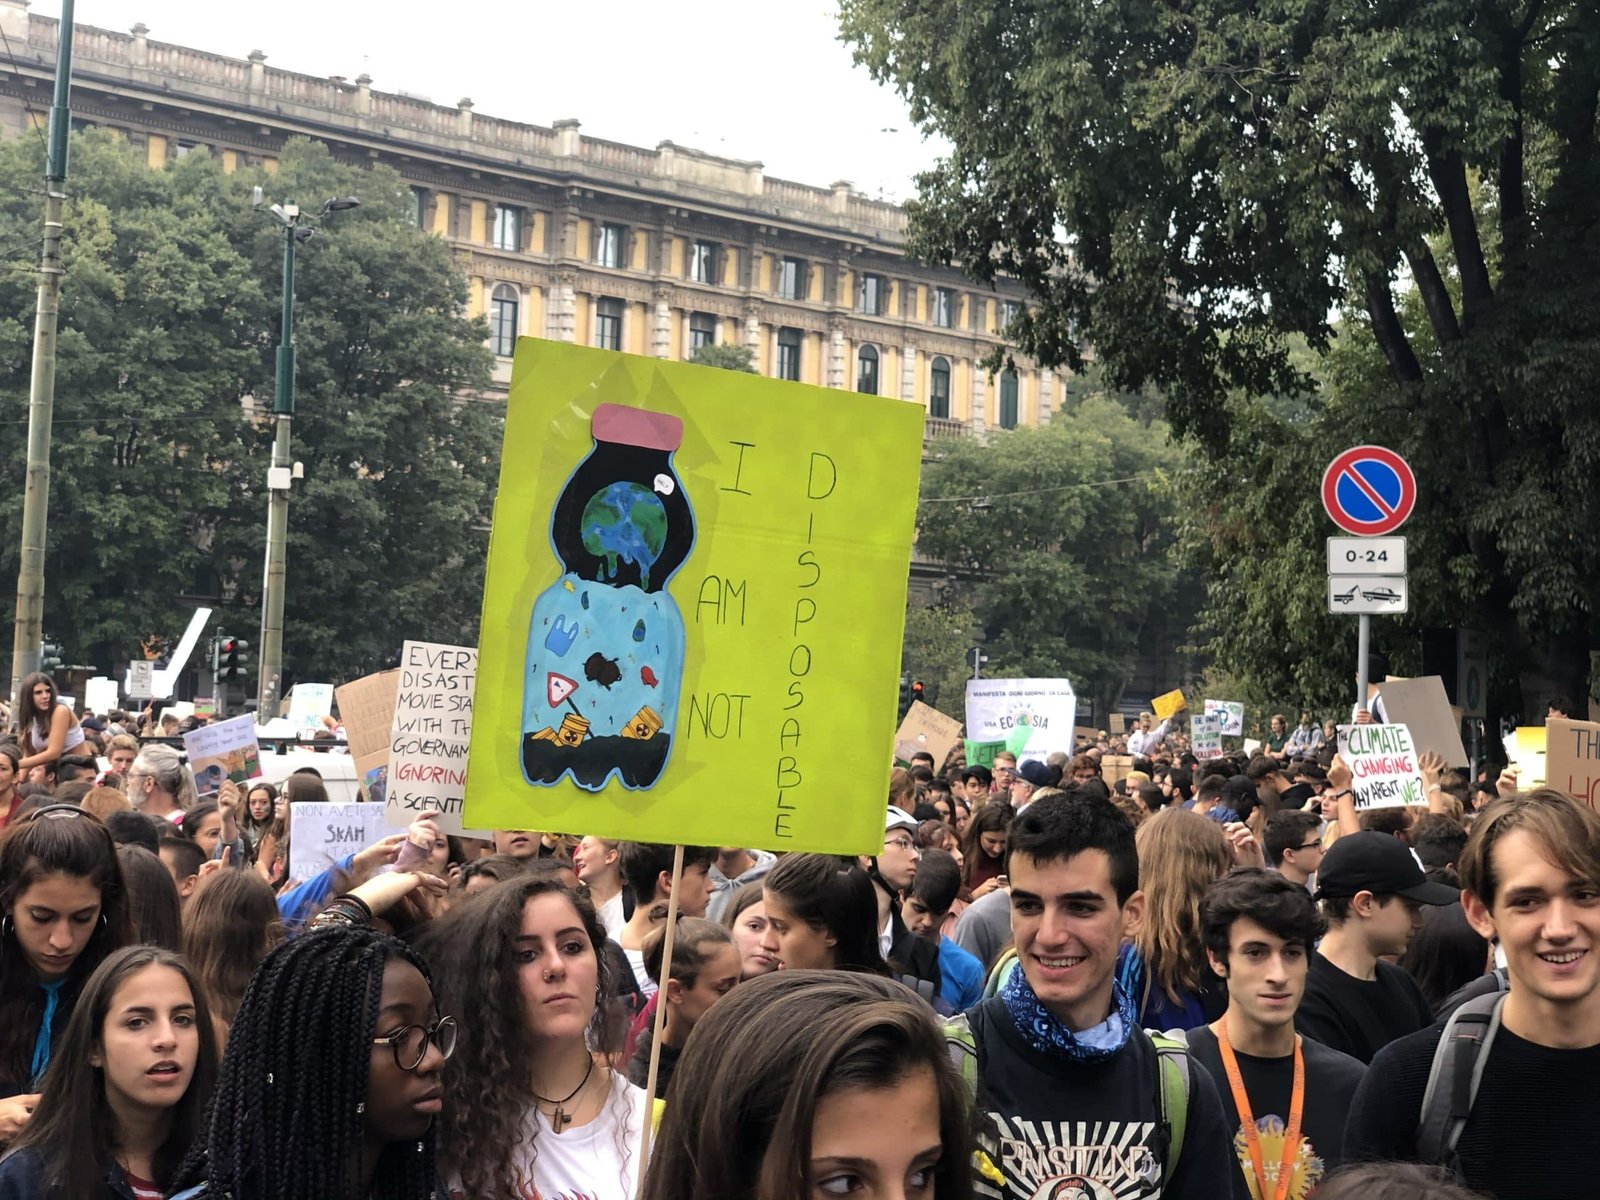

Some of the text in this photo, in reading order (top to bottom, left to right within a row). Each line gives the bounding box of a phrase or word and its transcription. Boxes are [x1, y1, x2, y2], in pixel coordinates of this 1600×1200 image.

[720, 441, 756, 495] I
[1346, 550, 1388, 562] 0-24
[696, 575, 746, 626] AM
[775, 452, 836, 838] DISPOSABLE
[398, 692, 444, 710] MOVIE
[397, 715, 442, 735] WITH
[688, 692, 751, 741] NOT
[1348, 726, 1410, 755] CLIMATE
[1569, 728, 1600, 760] TH
[1354, 756, 1413, 778] CHANGING
[387, 789, 399, 808] A
[1400, 776, 1425, 804] WE?
[296, 804, 323, 816] NON
[1000, 1136, 1149, 1181] PRISTIN
